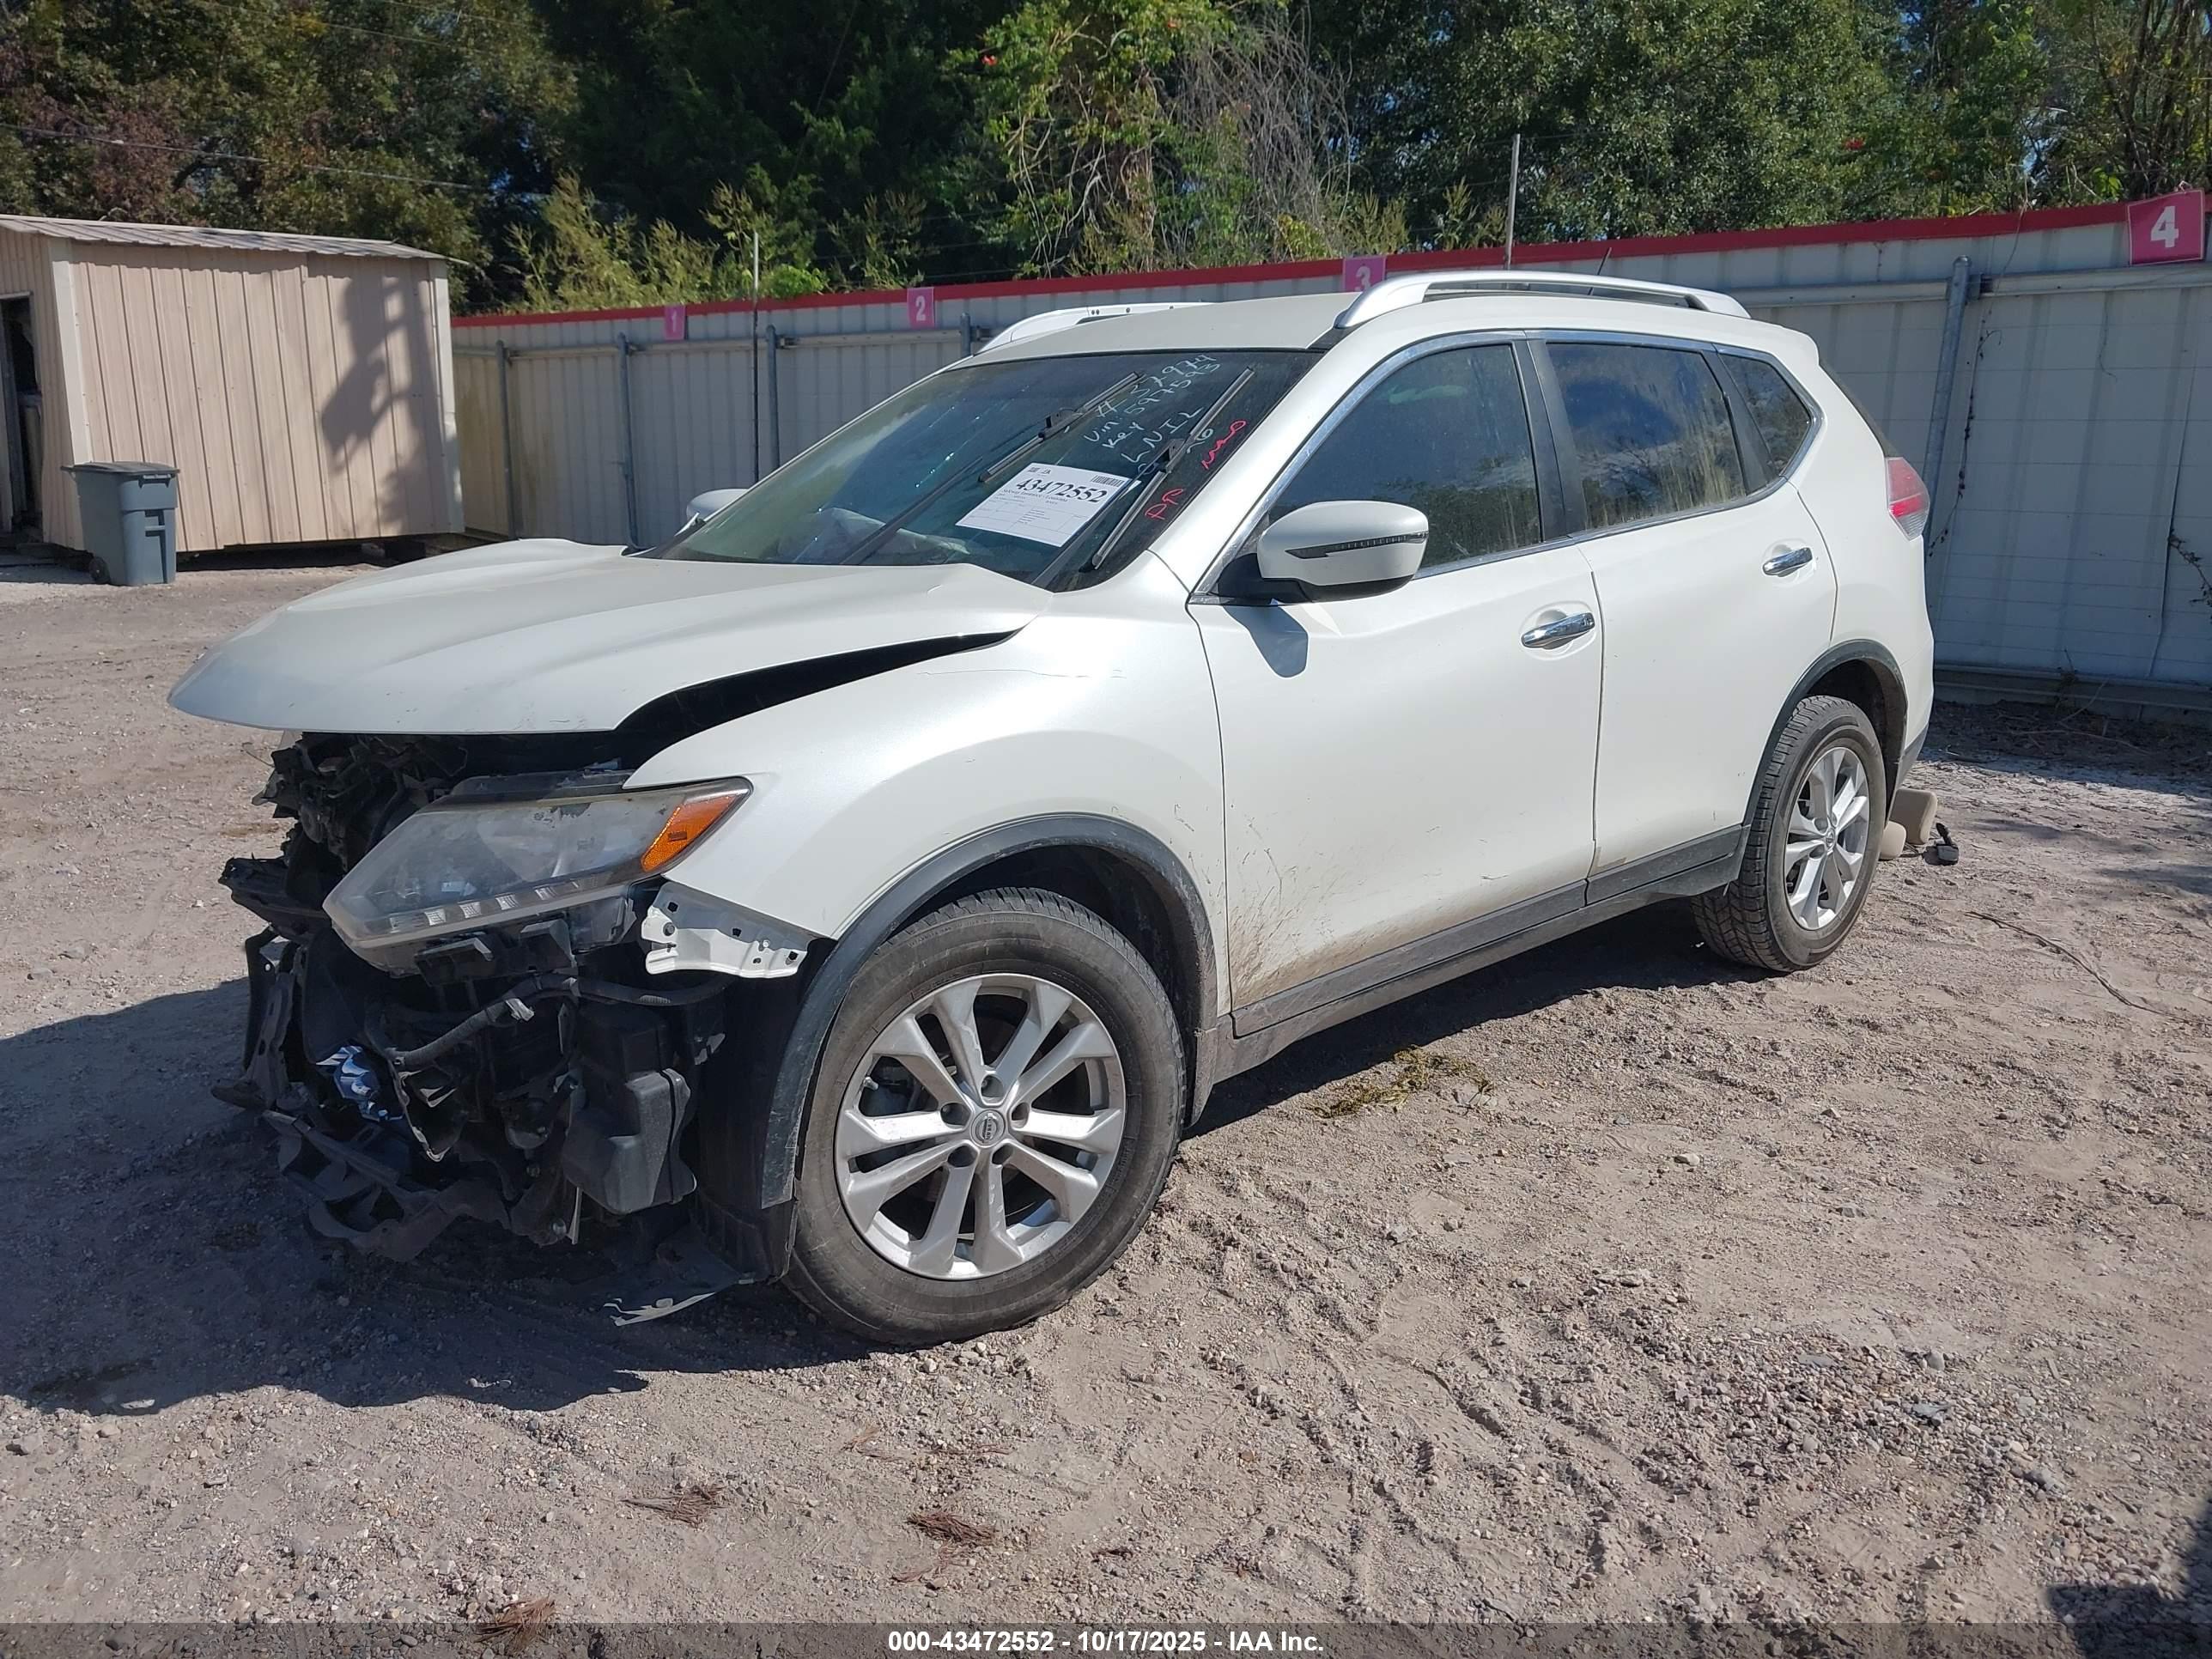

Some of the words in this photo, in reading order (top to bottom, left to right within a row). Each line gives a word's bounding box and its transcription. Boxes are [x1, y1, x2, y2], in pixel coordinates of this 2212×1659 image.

[2150, 205, 2179, 248] 4
[1355, 265, 1371, 292] 3
[915, 295, 926, 321] 2
[1016, 477, 1109, 503] 43472552
